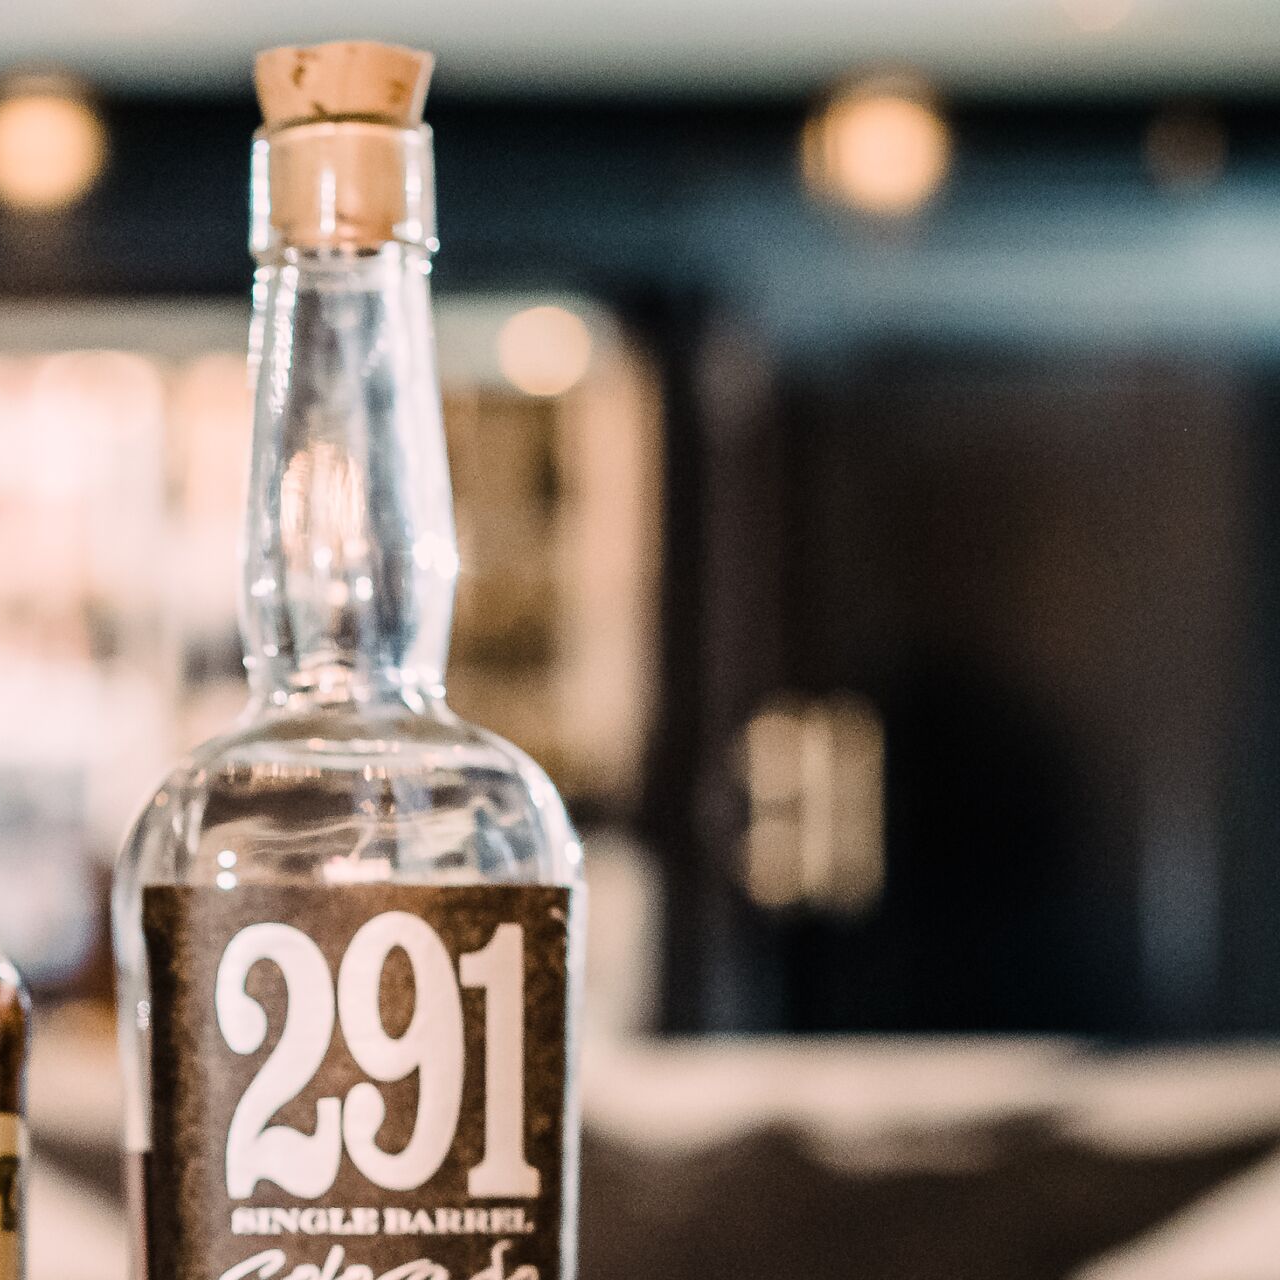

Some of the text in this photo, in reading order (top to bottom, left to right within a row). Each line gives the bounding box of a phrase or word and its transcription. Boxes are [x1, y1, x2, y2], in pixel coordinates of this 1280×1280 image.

[216, 910, 540, 1199] 291
[231, 1207, 535, 1235] SINGLE BARREL
